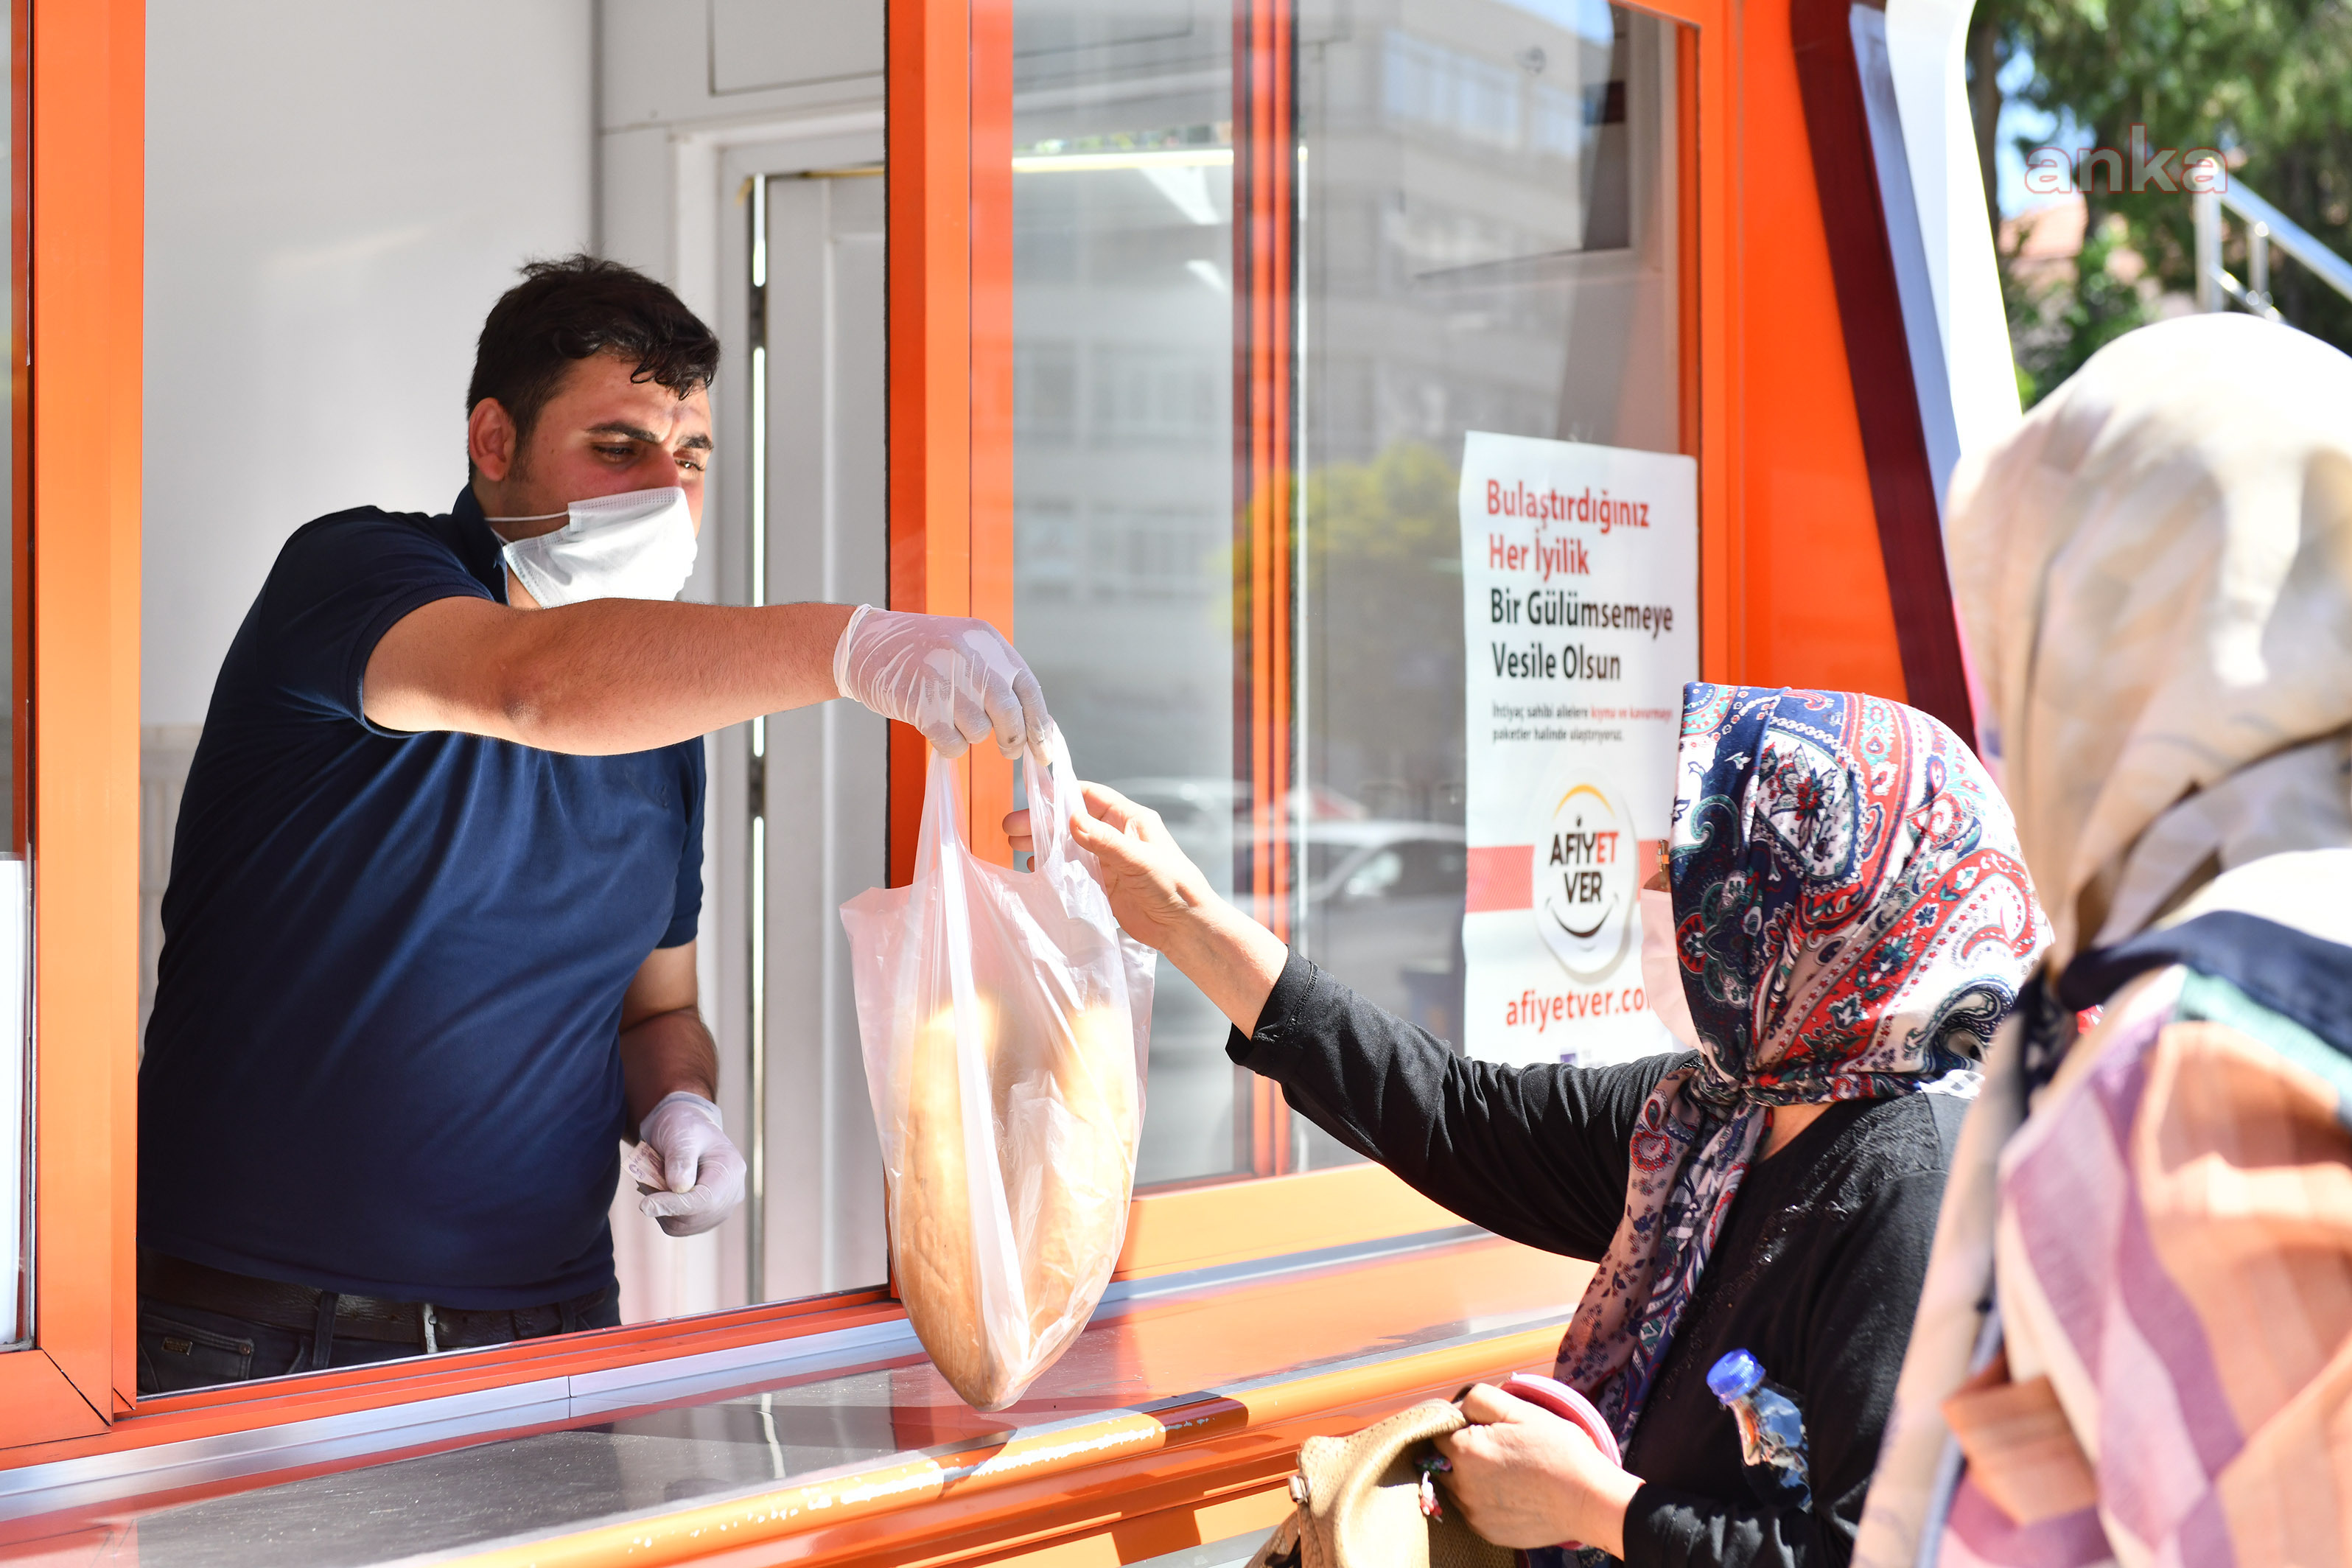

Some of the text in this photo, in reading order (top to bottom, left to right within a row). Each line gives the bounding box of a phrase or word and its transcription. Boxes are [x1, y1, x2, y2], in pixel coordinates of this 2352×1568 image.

[1487, 479, 1650, 535] Bulaştırdığınız
[1489, 529, 1590, 582] Her İyilik
[1491, 588, 1673, 640] Bir Gülümsemeye
[1492, 642, 1622, 679] Vesile Olsun
[1564, 870, 1603, 904] VER
[1506, 987, 1651, 1033] afiyetver.co
